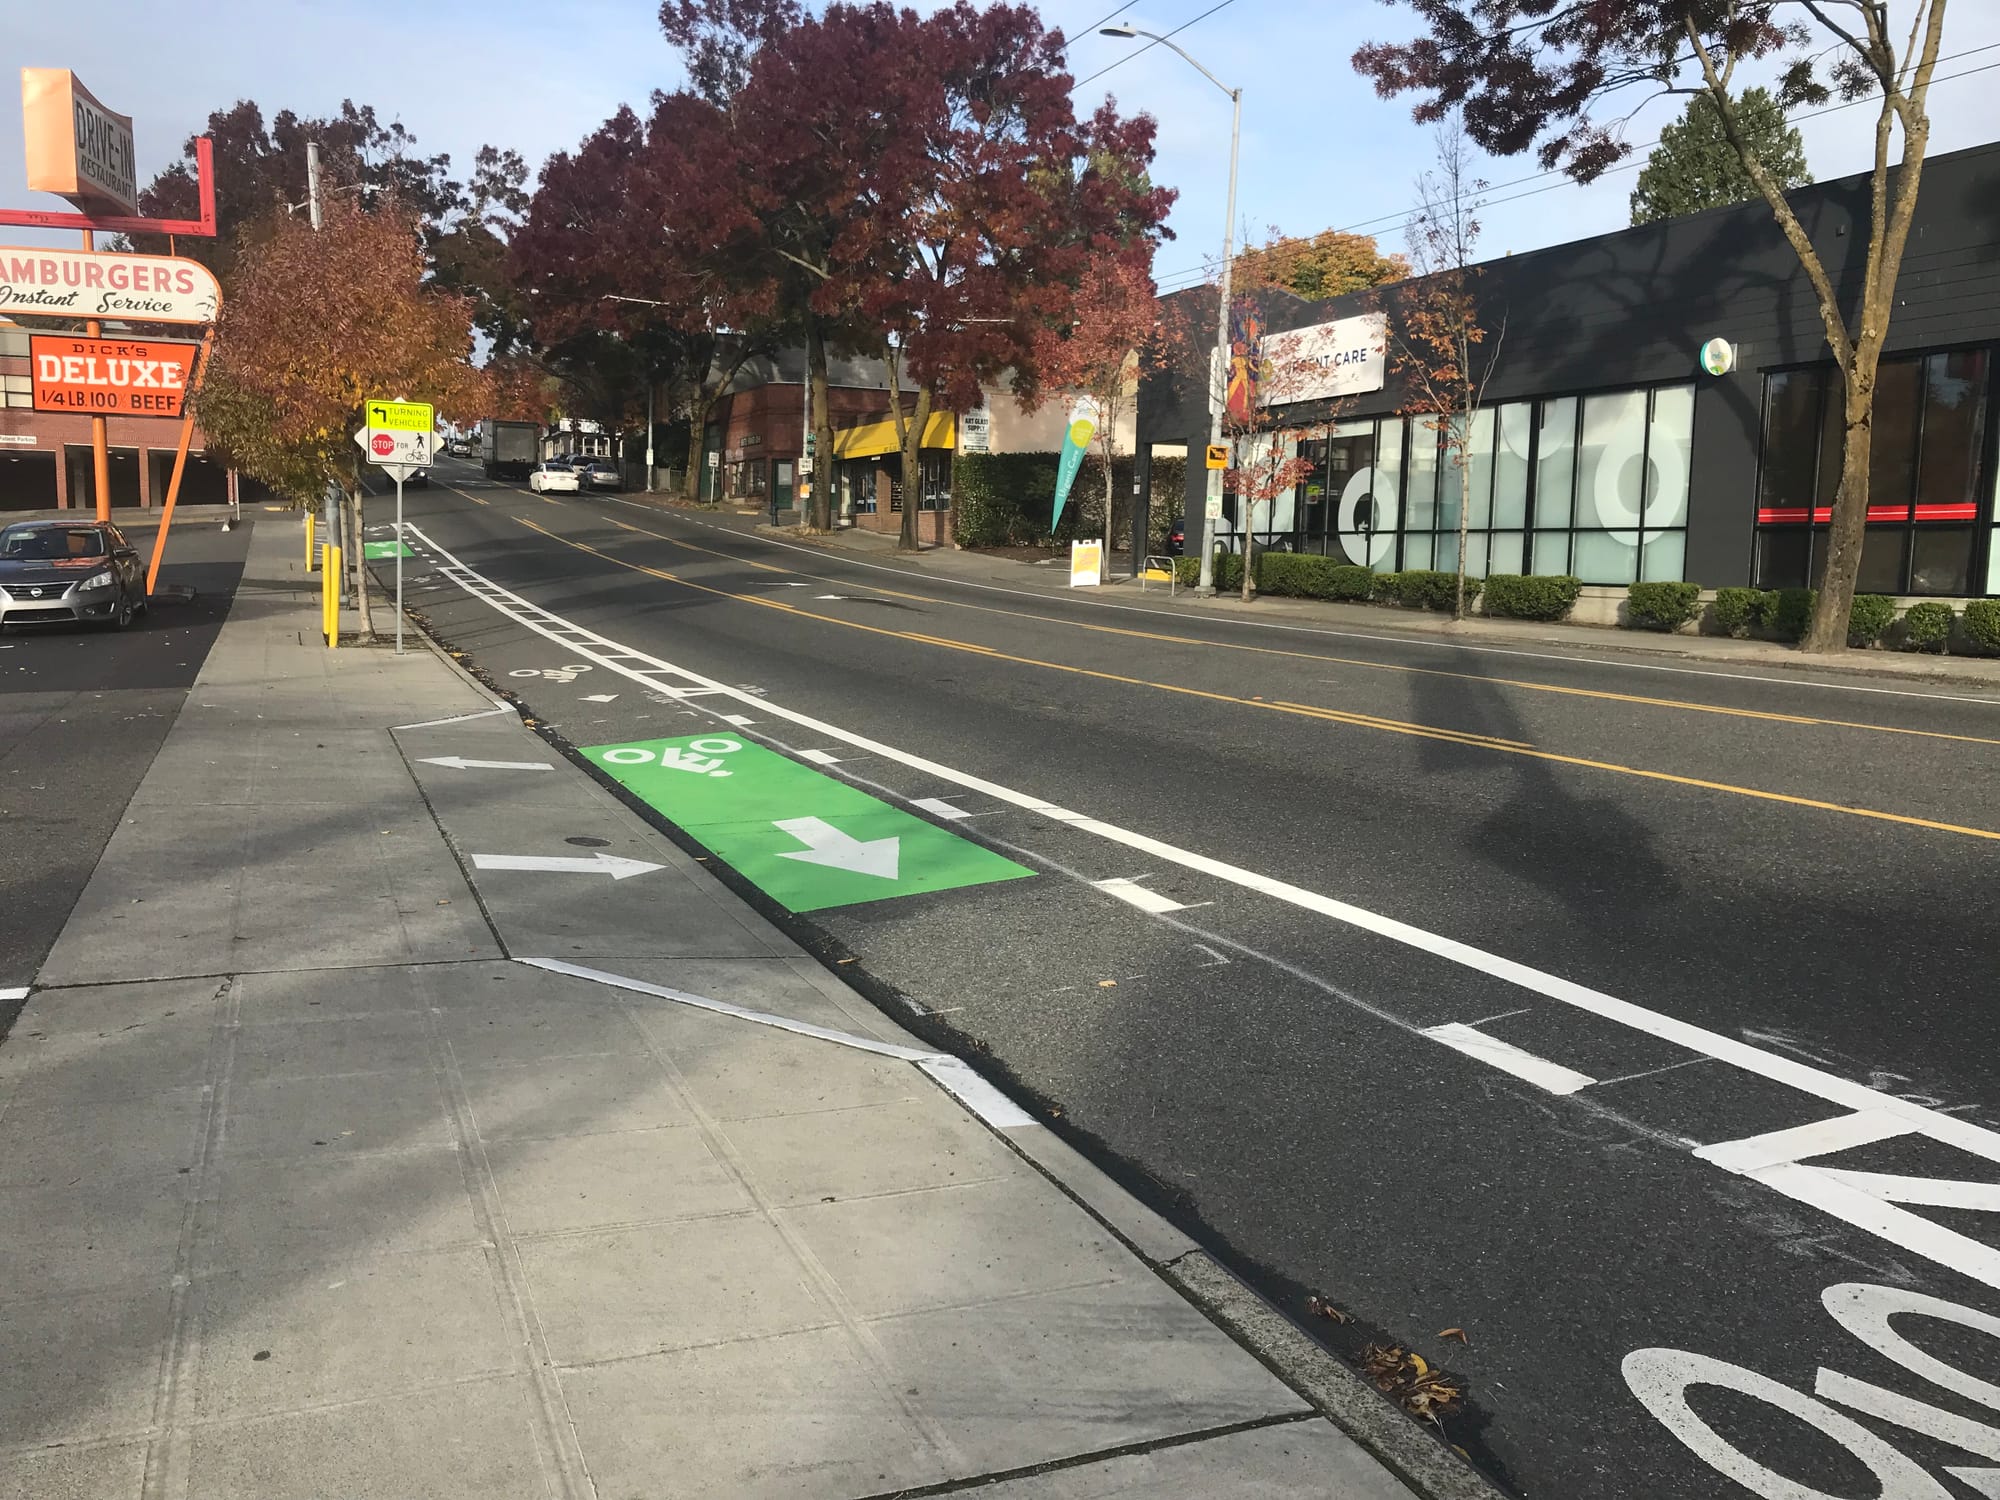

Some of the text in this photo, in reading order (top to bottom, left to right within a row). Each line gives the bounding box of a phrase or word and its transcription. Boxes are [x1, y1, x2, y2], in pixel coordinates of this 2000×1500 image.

[75, 100, 133, 182] DRIVE-IN
[80, 154, 132, 200] RESTAURANT
[0, 285, 174, 314] Instant Service
[72, 343, 148, 357] DICK'S
[1334, 347, 1368, 367] CARE
[38, 354, 183, 390] DELUXE
[42, 389, 65, 406] 1/4
[131, 394, 176, 411] BEEF
[389, 408, 428, 417] TURNING
[389, 418, 428, 428] VEHICLES
[372, 439, 409, 450] STOP FOR
[1058, 450, 1079, 498] Urgent Care
